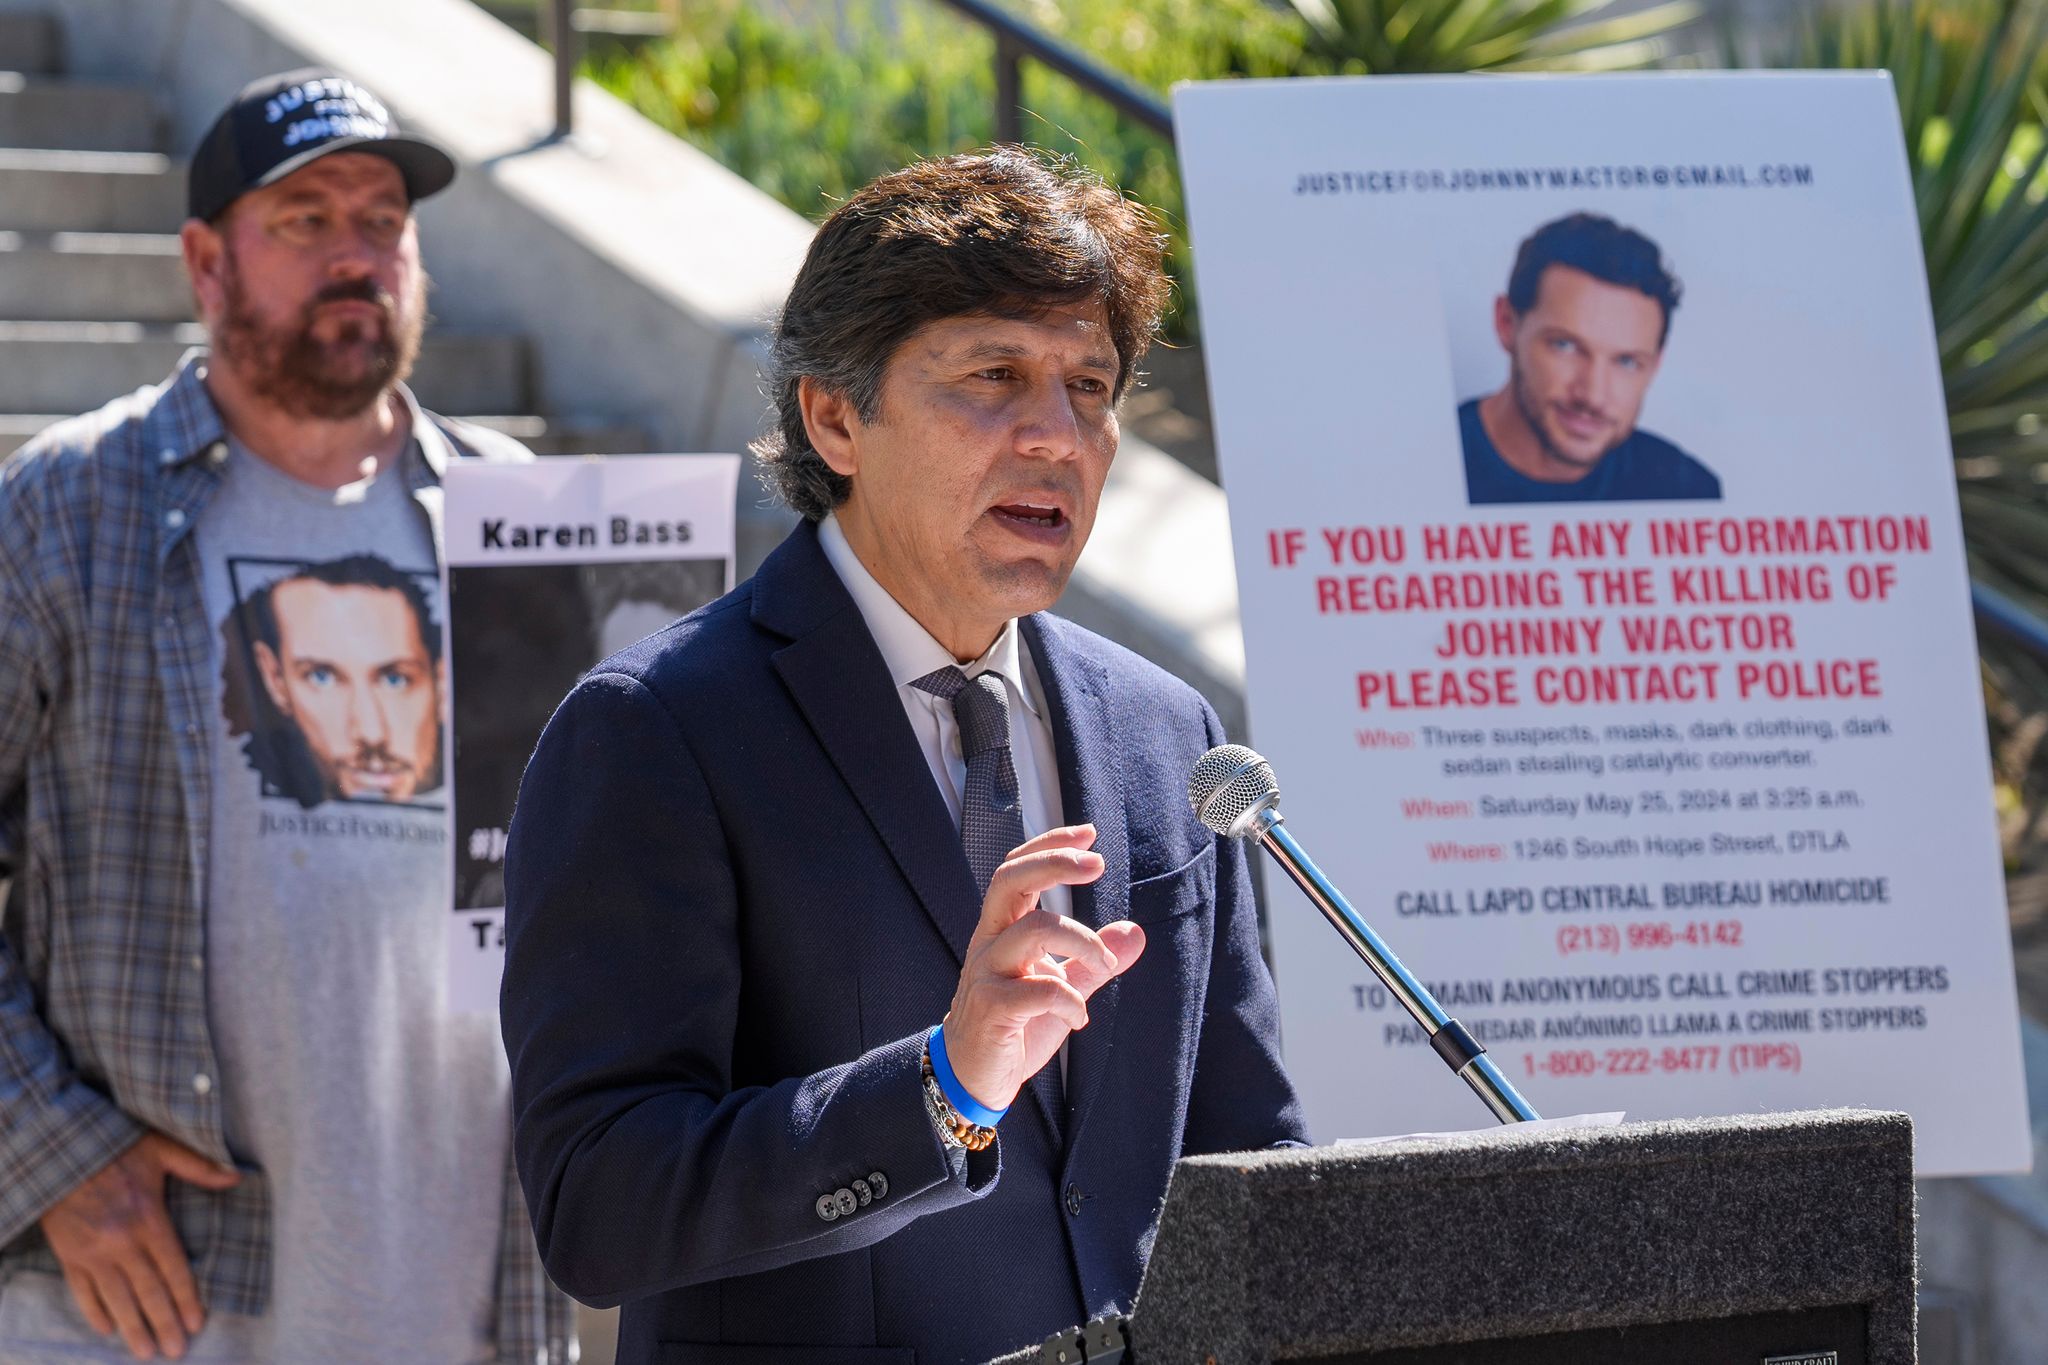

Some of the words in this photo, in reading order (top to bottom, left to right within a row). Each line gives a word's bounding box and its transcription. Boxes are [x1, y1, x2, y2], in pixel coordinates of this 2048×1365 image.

[1296, 164, 1814, 194] JUSTICEFORJOHNNYWACTOR@GMAIL.COM
[480, 519, 597, 549] Karen
[610, 515, 693, 546] Bass
[1268, 529, 1306, 567] IF
[1323, 526, 1405, 565] YOU
[1423, 523, 1532, 562] HAVE
[1551, 520, 1631, 559] ANY
[1649, 515, 1931, 556] INFORMATION
[1316, 569, 1562, 613] REGARDING
[1576, 566, 1656, 606] THE
[1671, 563, 1833, 604] KILLING
[1847, 563, 1897, 602] OF
[1436, 616, 1605, 658] JOHNNY
[1620, 613, 1795, 654] WACTOR
[1357, 667, 1519, 710] PLEASE
[1535, 662, 1720, 705] CONTACT
[1737, 660, 1881, 701] POLICE
[1357, 729, 1415, 749] Who:
[1422, 726, 1486, 746] Three
[1491, 723, 1599, 748] suspects,
[1605, 720, 1684, 742] masks,
[1688, 718, 1738, 740] dark
[1744, 716, 1838, 743] clothing,
[1842, 715, 1892, 737] dark
[1442, 755, 1511, 777] sedan
[1516, 752, 1605, 778] stealing
[1609, 749, 1703, 776] catalytic
[1707, 748, 1818, 771] converter.
[1402, 798, 1474, 820] When:
[1479, 793, 1580, 820] Saturday
[1586, 791, 1635, 819] May
[1639, 789, 1674, 814] 25,
[1677, 787, 1732, 812] 2024
[1736, 790, 1760, 810] at
[1763, 786, 1813, 810] 3:25
[1816, 788, 1864, 809] a.m.
[1427, 840, 1508, 863] Where:
[1515, 838, 1568, 861] 1246
[1573, 835, 1639, 859] South
[1644, 833, 1705, 859] Hope
[1709, 831, 1784, 856] Street,
[1786, 829, 1849, 853] DTLA
[1397, 888, 1460, 917] CALL
[1466, 886, 1534, 915] LAPD
[1540, 883, 1656, 912] CENTRAL
[1662, 880, 1762, 909] BUREAU
[1768, 877, 1891, 906] HOMICIDE
[1557, 924, 1621, 955] (213)
[1627, 918, 1744, 950] 996-4142
[1352, 982, 1386, 1010] TO
[1395, 978, 1494, 1006] MAIN
[1501, 974, 1660, 1005] ANONYMOUS
[1667, 972, 1730, 1000] CALL
[1736, 968, 1817, 997] CRIME
[1822, 964, 1950, 995] STOPPERS
[1468, 1015, 1537, 1043] UEDAR
[1542, 1009, 1643, 1041] ANÓNIMO
[1648, 1010, 1721, 1037] LLAMA
[1726, 1009, 1743, 1035] A
[1746, 1007, 1813, 1033] CRIME
[1817, 1004, 1928, 1032] STOPPERS
[1522, 1045, 1722, 1078] 1-800-222-8477
[1728, 1041, 1804, 1075] (TIPS)
